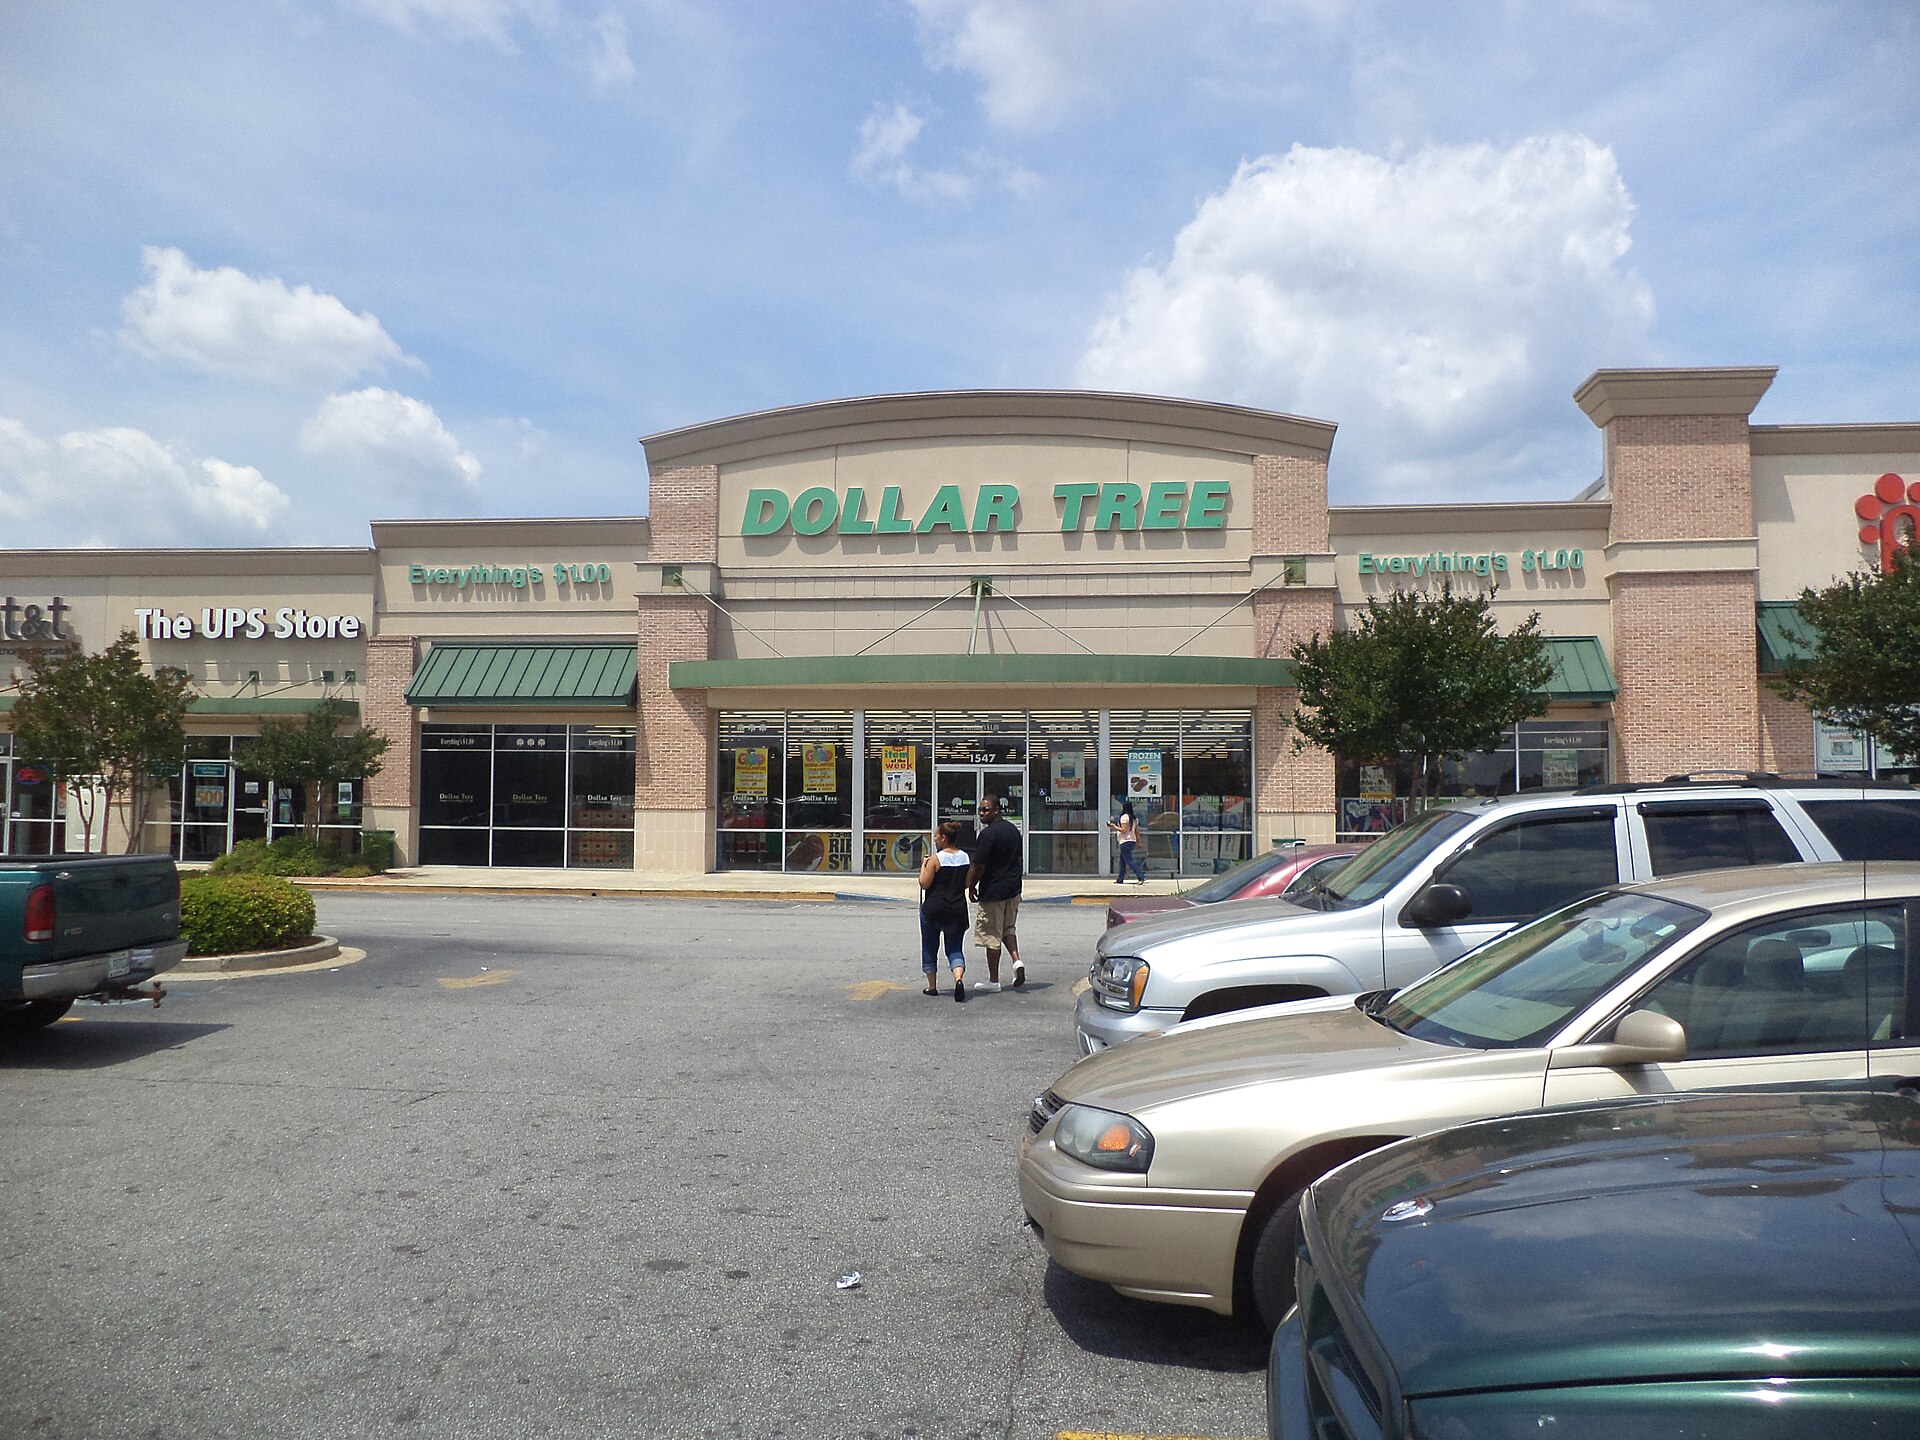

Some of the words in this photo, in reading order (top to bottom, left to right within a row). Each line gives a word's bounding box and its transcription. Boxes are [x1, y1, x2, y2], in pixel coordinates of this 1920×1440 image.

[740, 483, 1020, 536] DOLLAR
[1052, 481, 1231, 531] TREE
[1358, 552, 1509, 578] Everything's
[1521, 549, 1584, 572] $1.00
[408, 564, 543, 589] Everything's
[553, 563, 611, 585] $1.00
[134, 608, 192, 640] The
[201, 608, 266, 640] UPS
[274, 607, 360, 639] Store
[885, 749, 909, 758] item
[969, 754, 996, 763] 1547
[1128, 752, 1161, 760] FROZEN
[829, 838, 887, 854] RIYE
[829, 854, 887, 871] STAK
